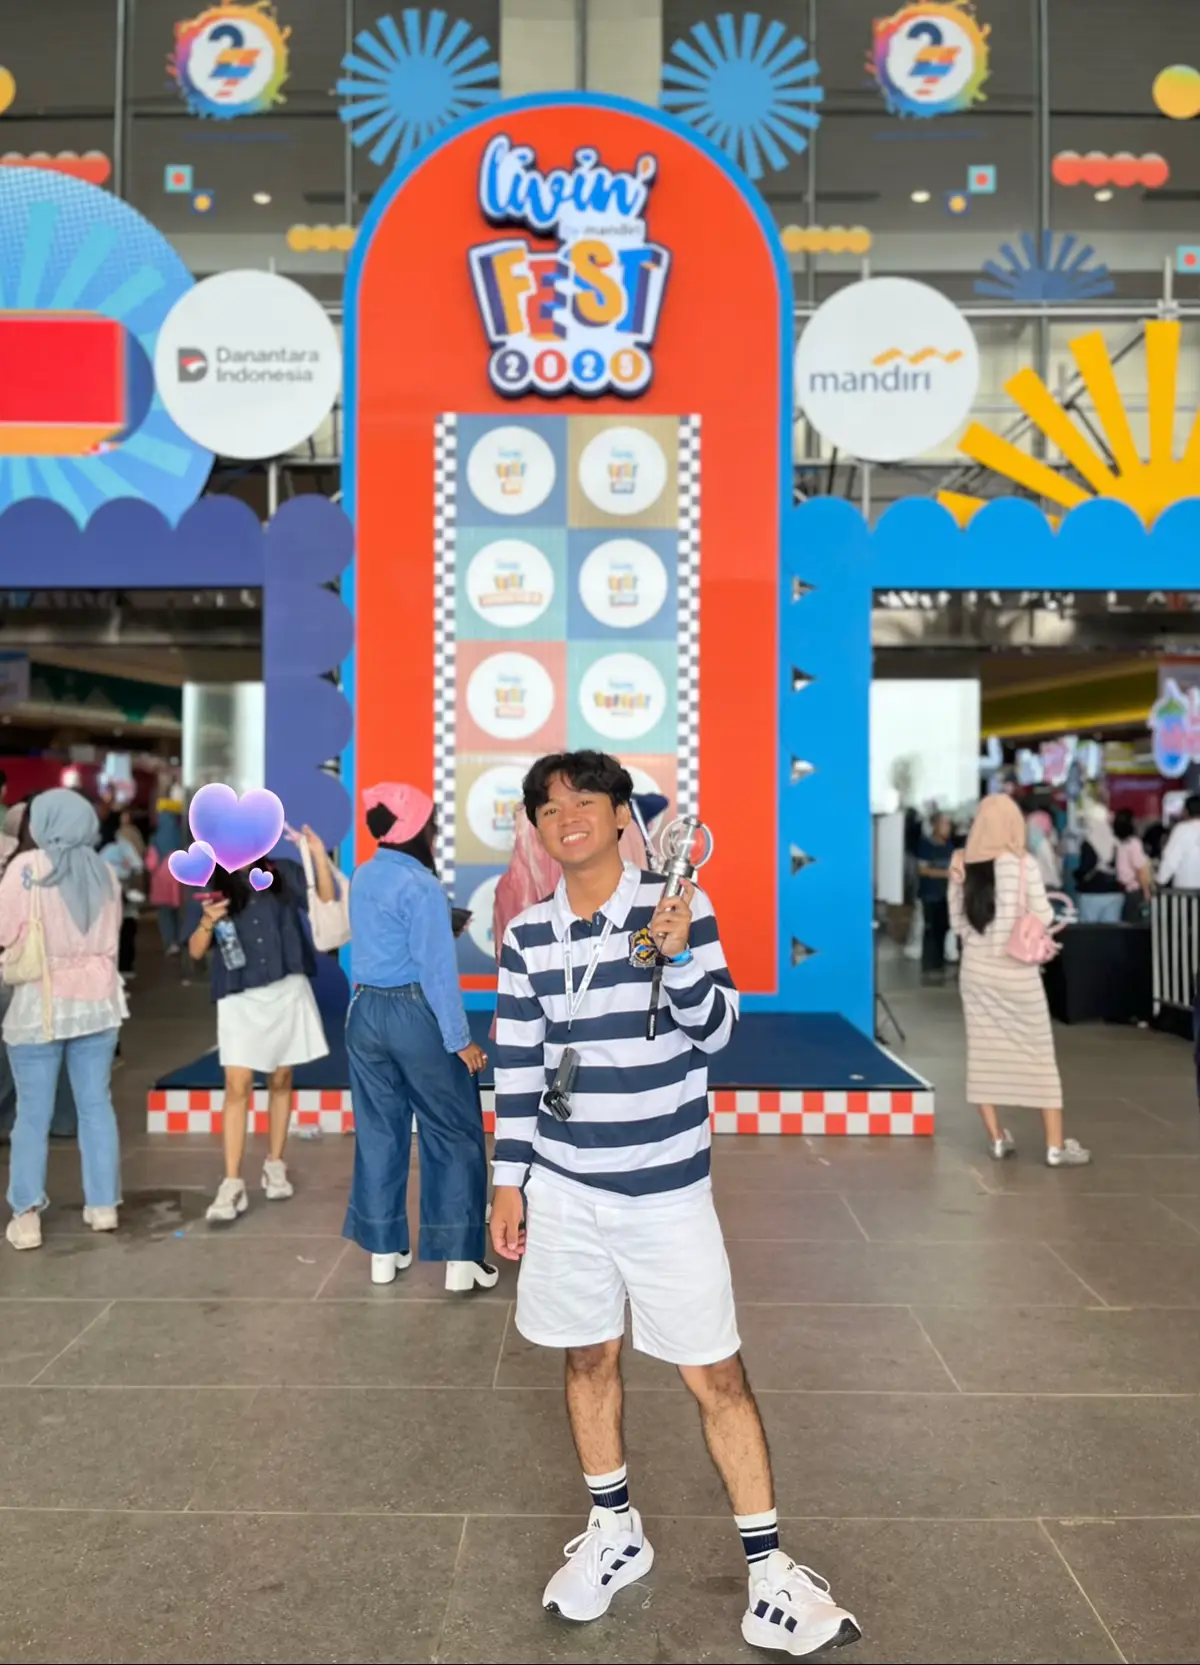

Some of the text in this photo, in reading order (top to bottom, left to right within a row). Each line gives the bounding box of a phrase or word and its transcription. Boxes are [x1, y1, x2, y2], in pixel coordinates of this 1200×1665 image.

[478, 239, 662, 341] FEST
[216, 346, 320, 363] Danantara
[216, 367, 313, 382] Indonesia
[809, 363, 932, 393] mandiri
